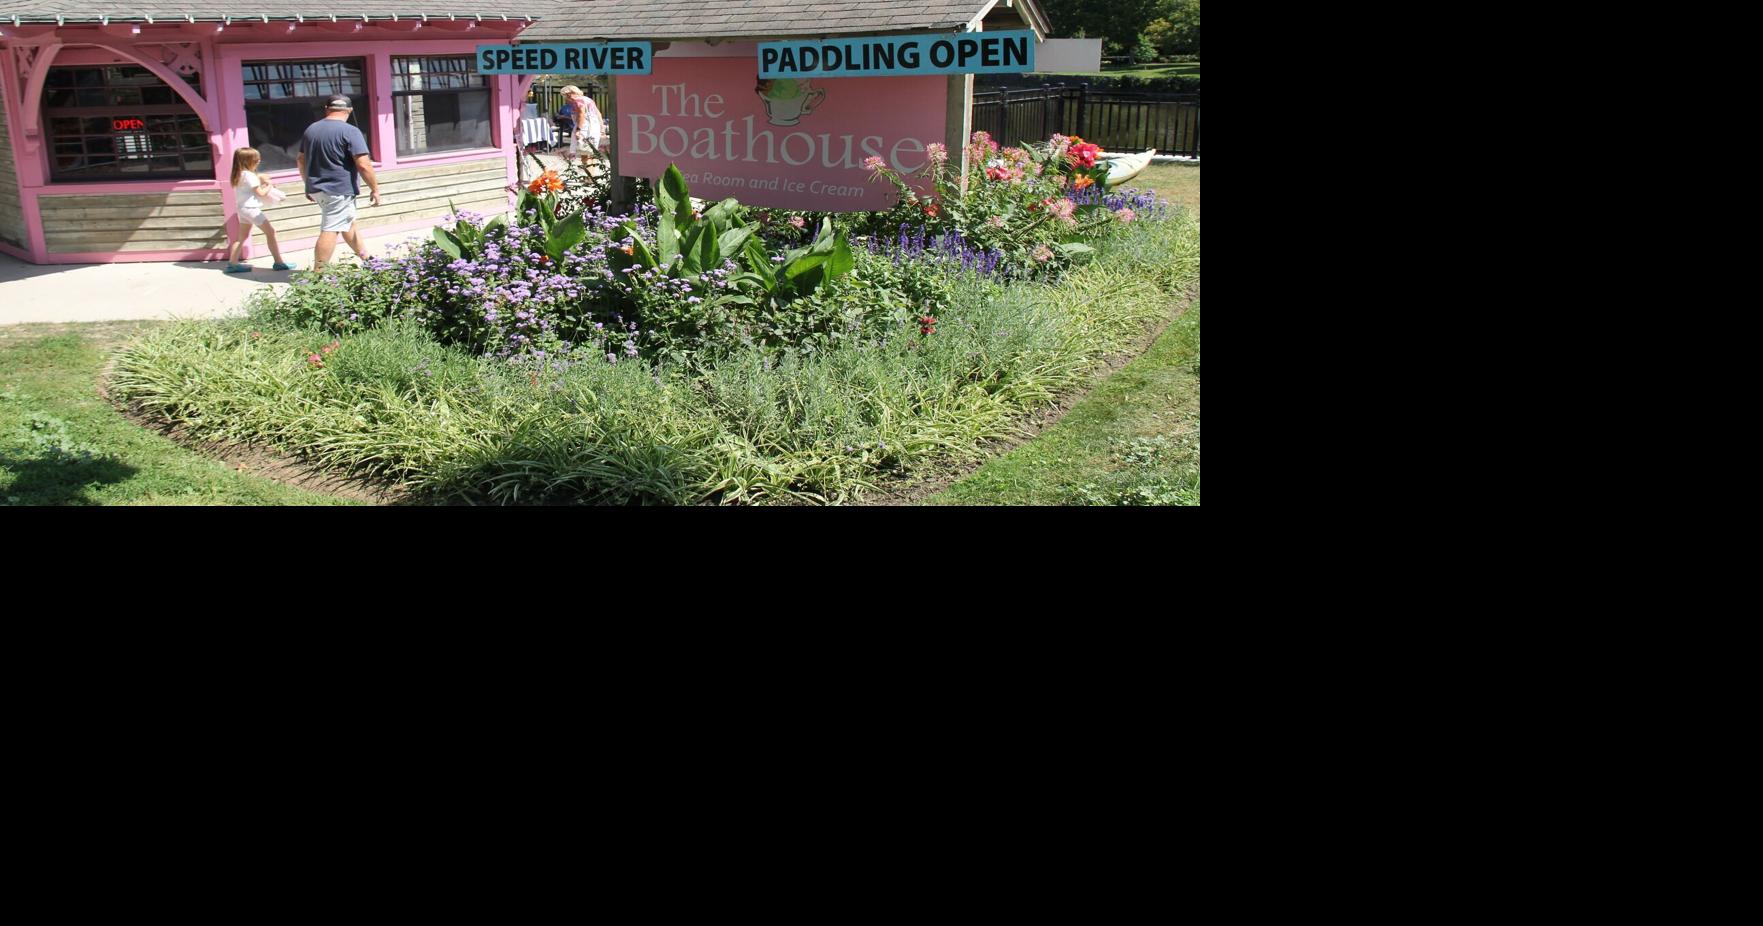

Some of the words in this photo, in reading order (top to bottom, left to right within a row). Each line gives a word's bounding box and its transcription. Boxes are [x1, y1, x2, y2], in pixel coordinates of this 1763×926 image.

[482, 48, 558, 71] SPEED
[565, 46, 644, 70] RIVER
[762, 41, 920, 73] PADDLING
[929, 36, 1028, 68] OPEN
[652, 82, 726, 118] The
[113, 119, 144, 130] OPEN
[627, 113, 927, 174] Boathouse
[703, 171, 745, 187] Room
[749, 176, 780, 191] and
[783, 178, 805, 193] Ice
[809, 180, 865, 198] Cream
